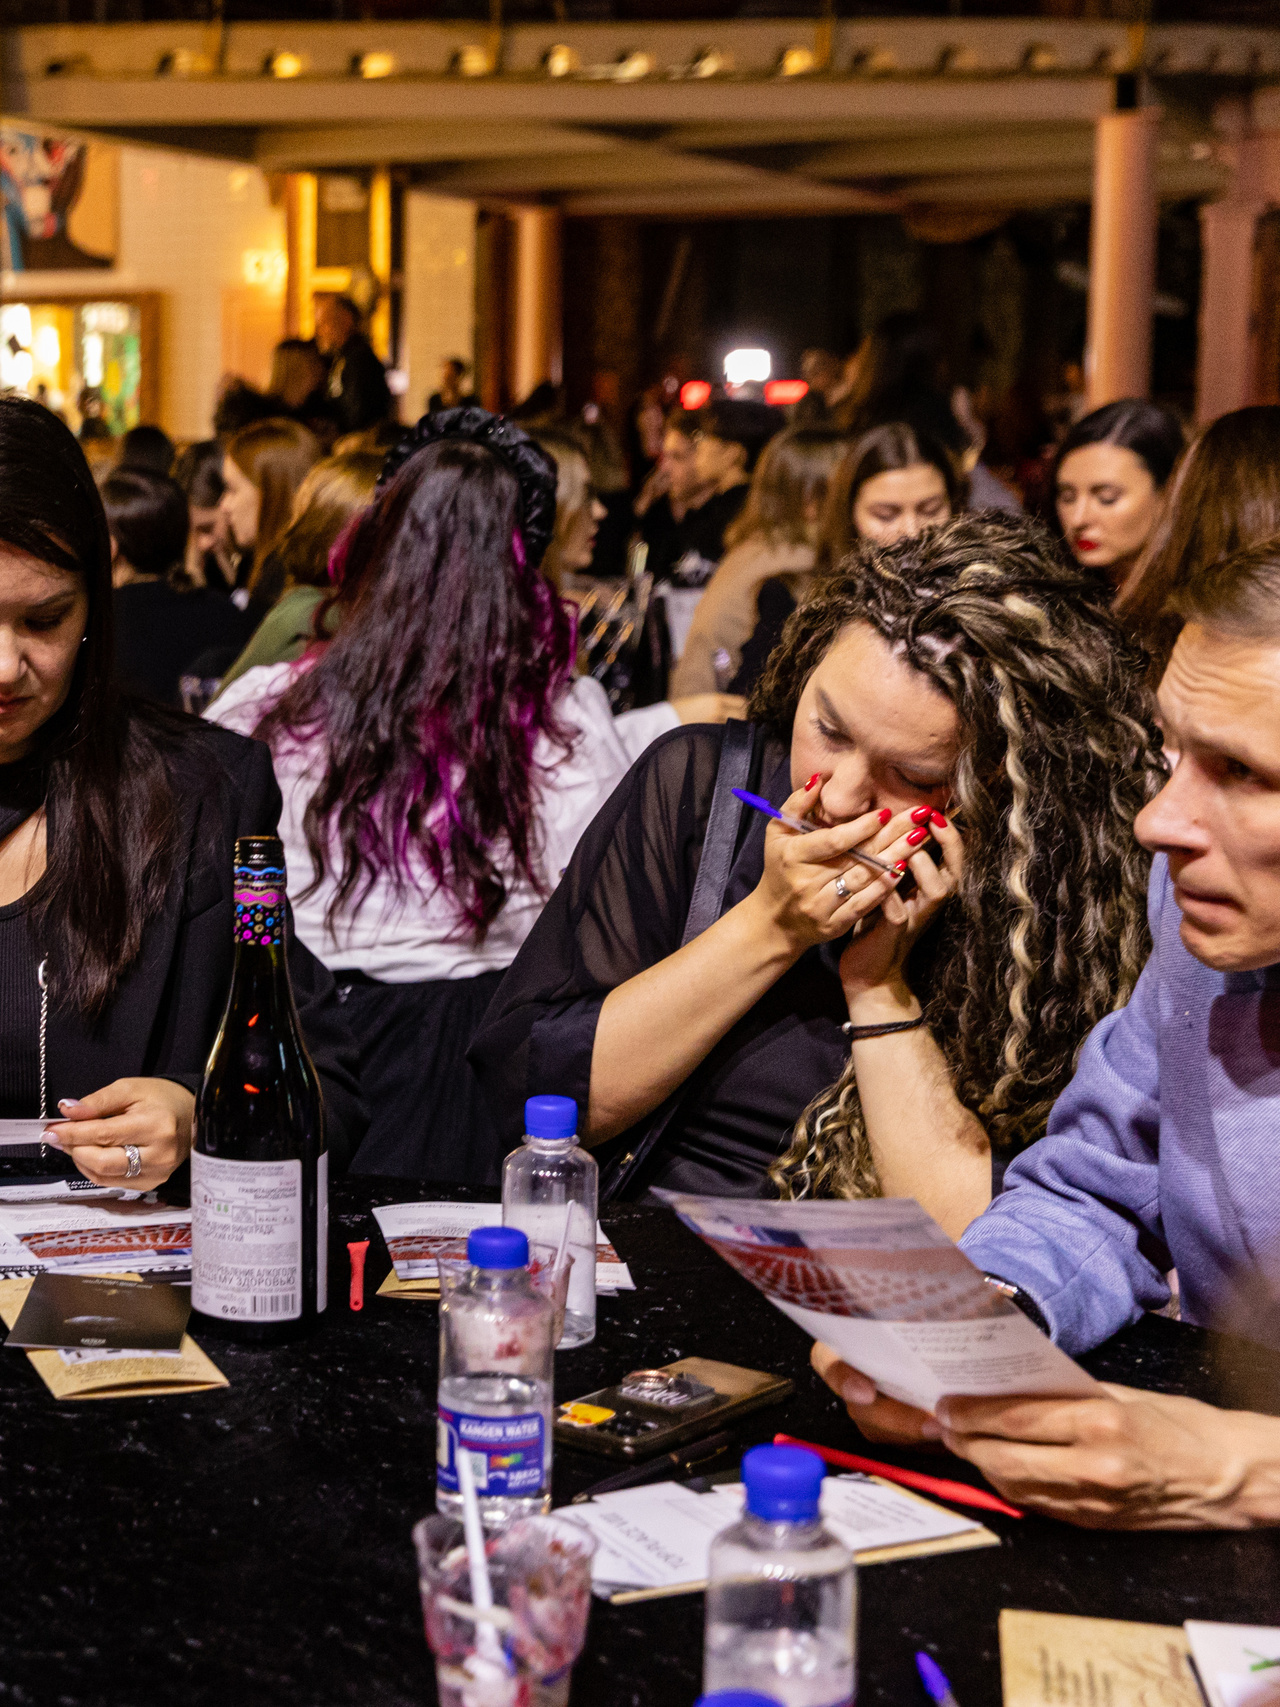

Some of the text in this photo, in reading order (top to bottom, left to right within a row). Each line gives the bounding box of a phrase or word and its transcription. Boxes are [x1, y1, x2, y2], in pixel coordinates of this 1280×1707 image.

[235, 1276, 296, 1288] ЗДОРОВЬЮ
[460, 1422, 503, 1438] KANGEN
[505, 1421, 540, 1437] WATER
